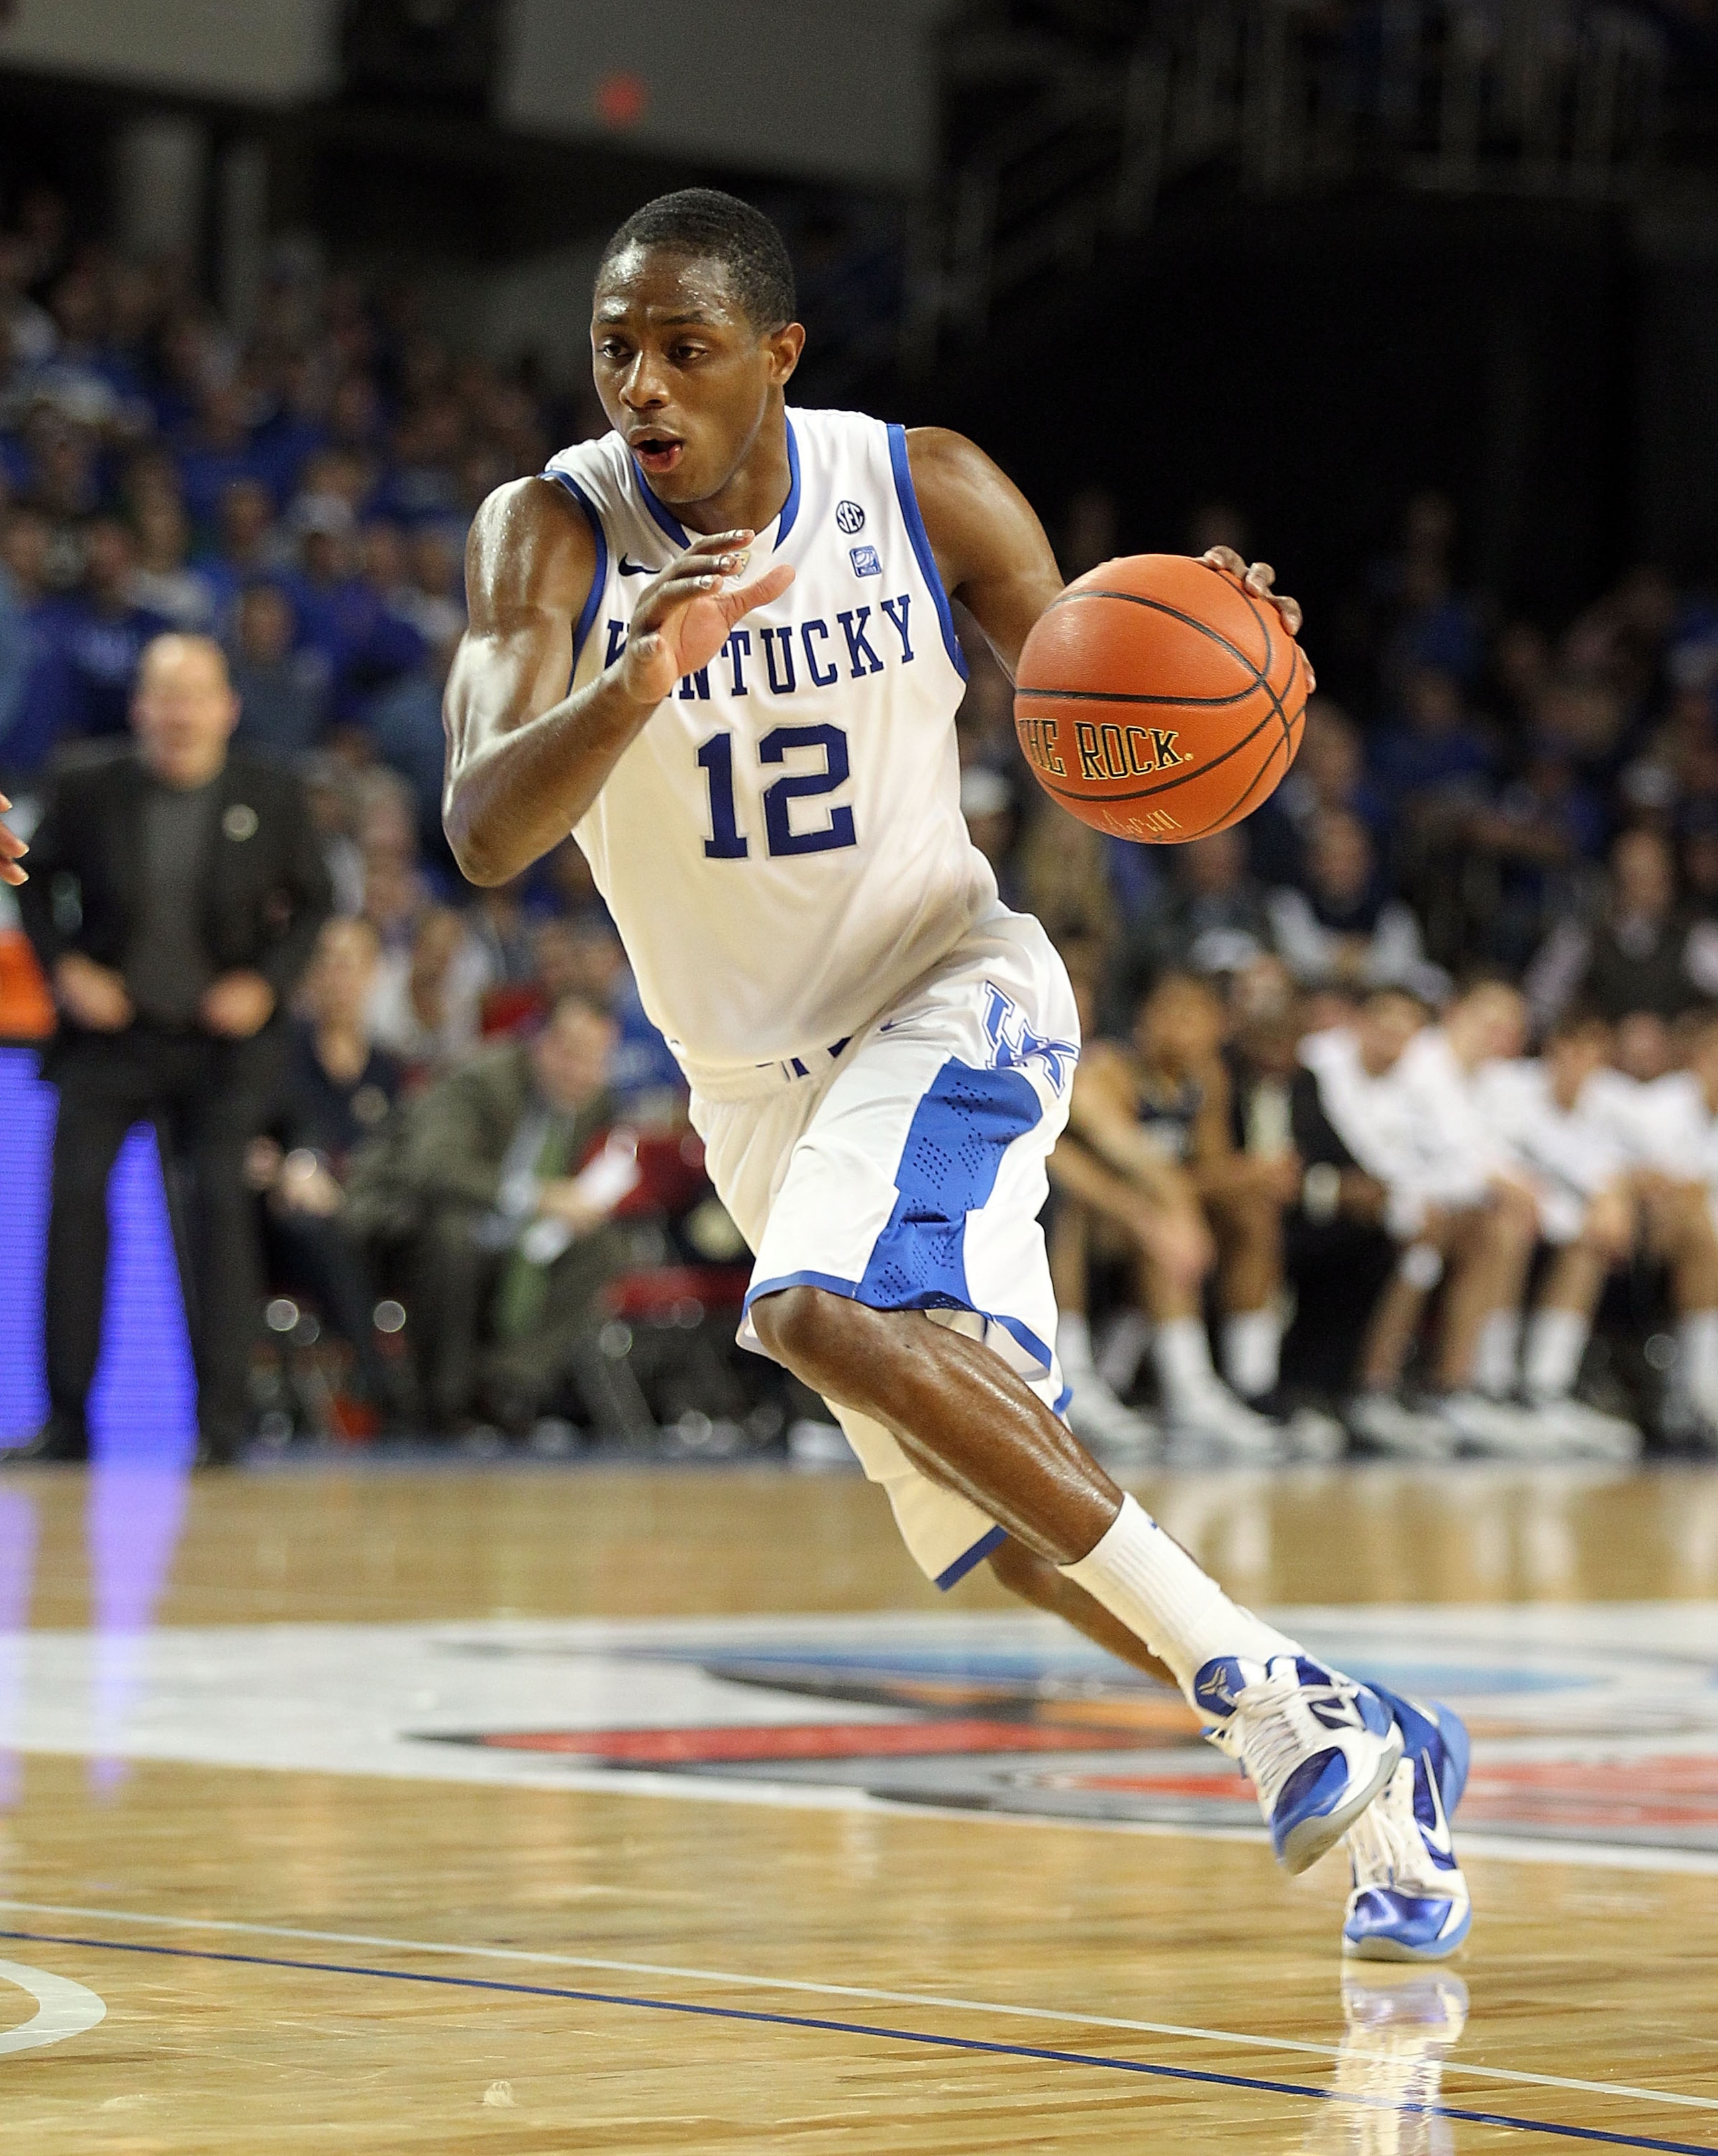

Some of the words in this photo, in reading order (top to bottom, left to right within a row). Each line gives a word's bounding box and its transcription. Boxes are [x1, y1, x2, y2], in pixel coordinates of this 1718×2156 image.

[836, 501, 865, 534] SEC
[604, 593, 915, 700] KTUCKY
[695, 722, 858, 861] 12
